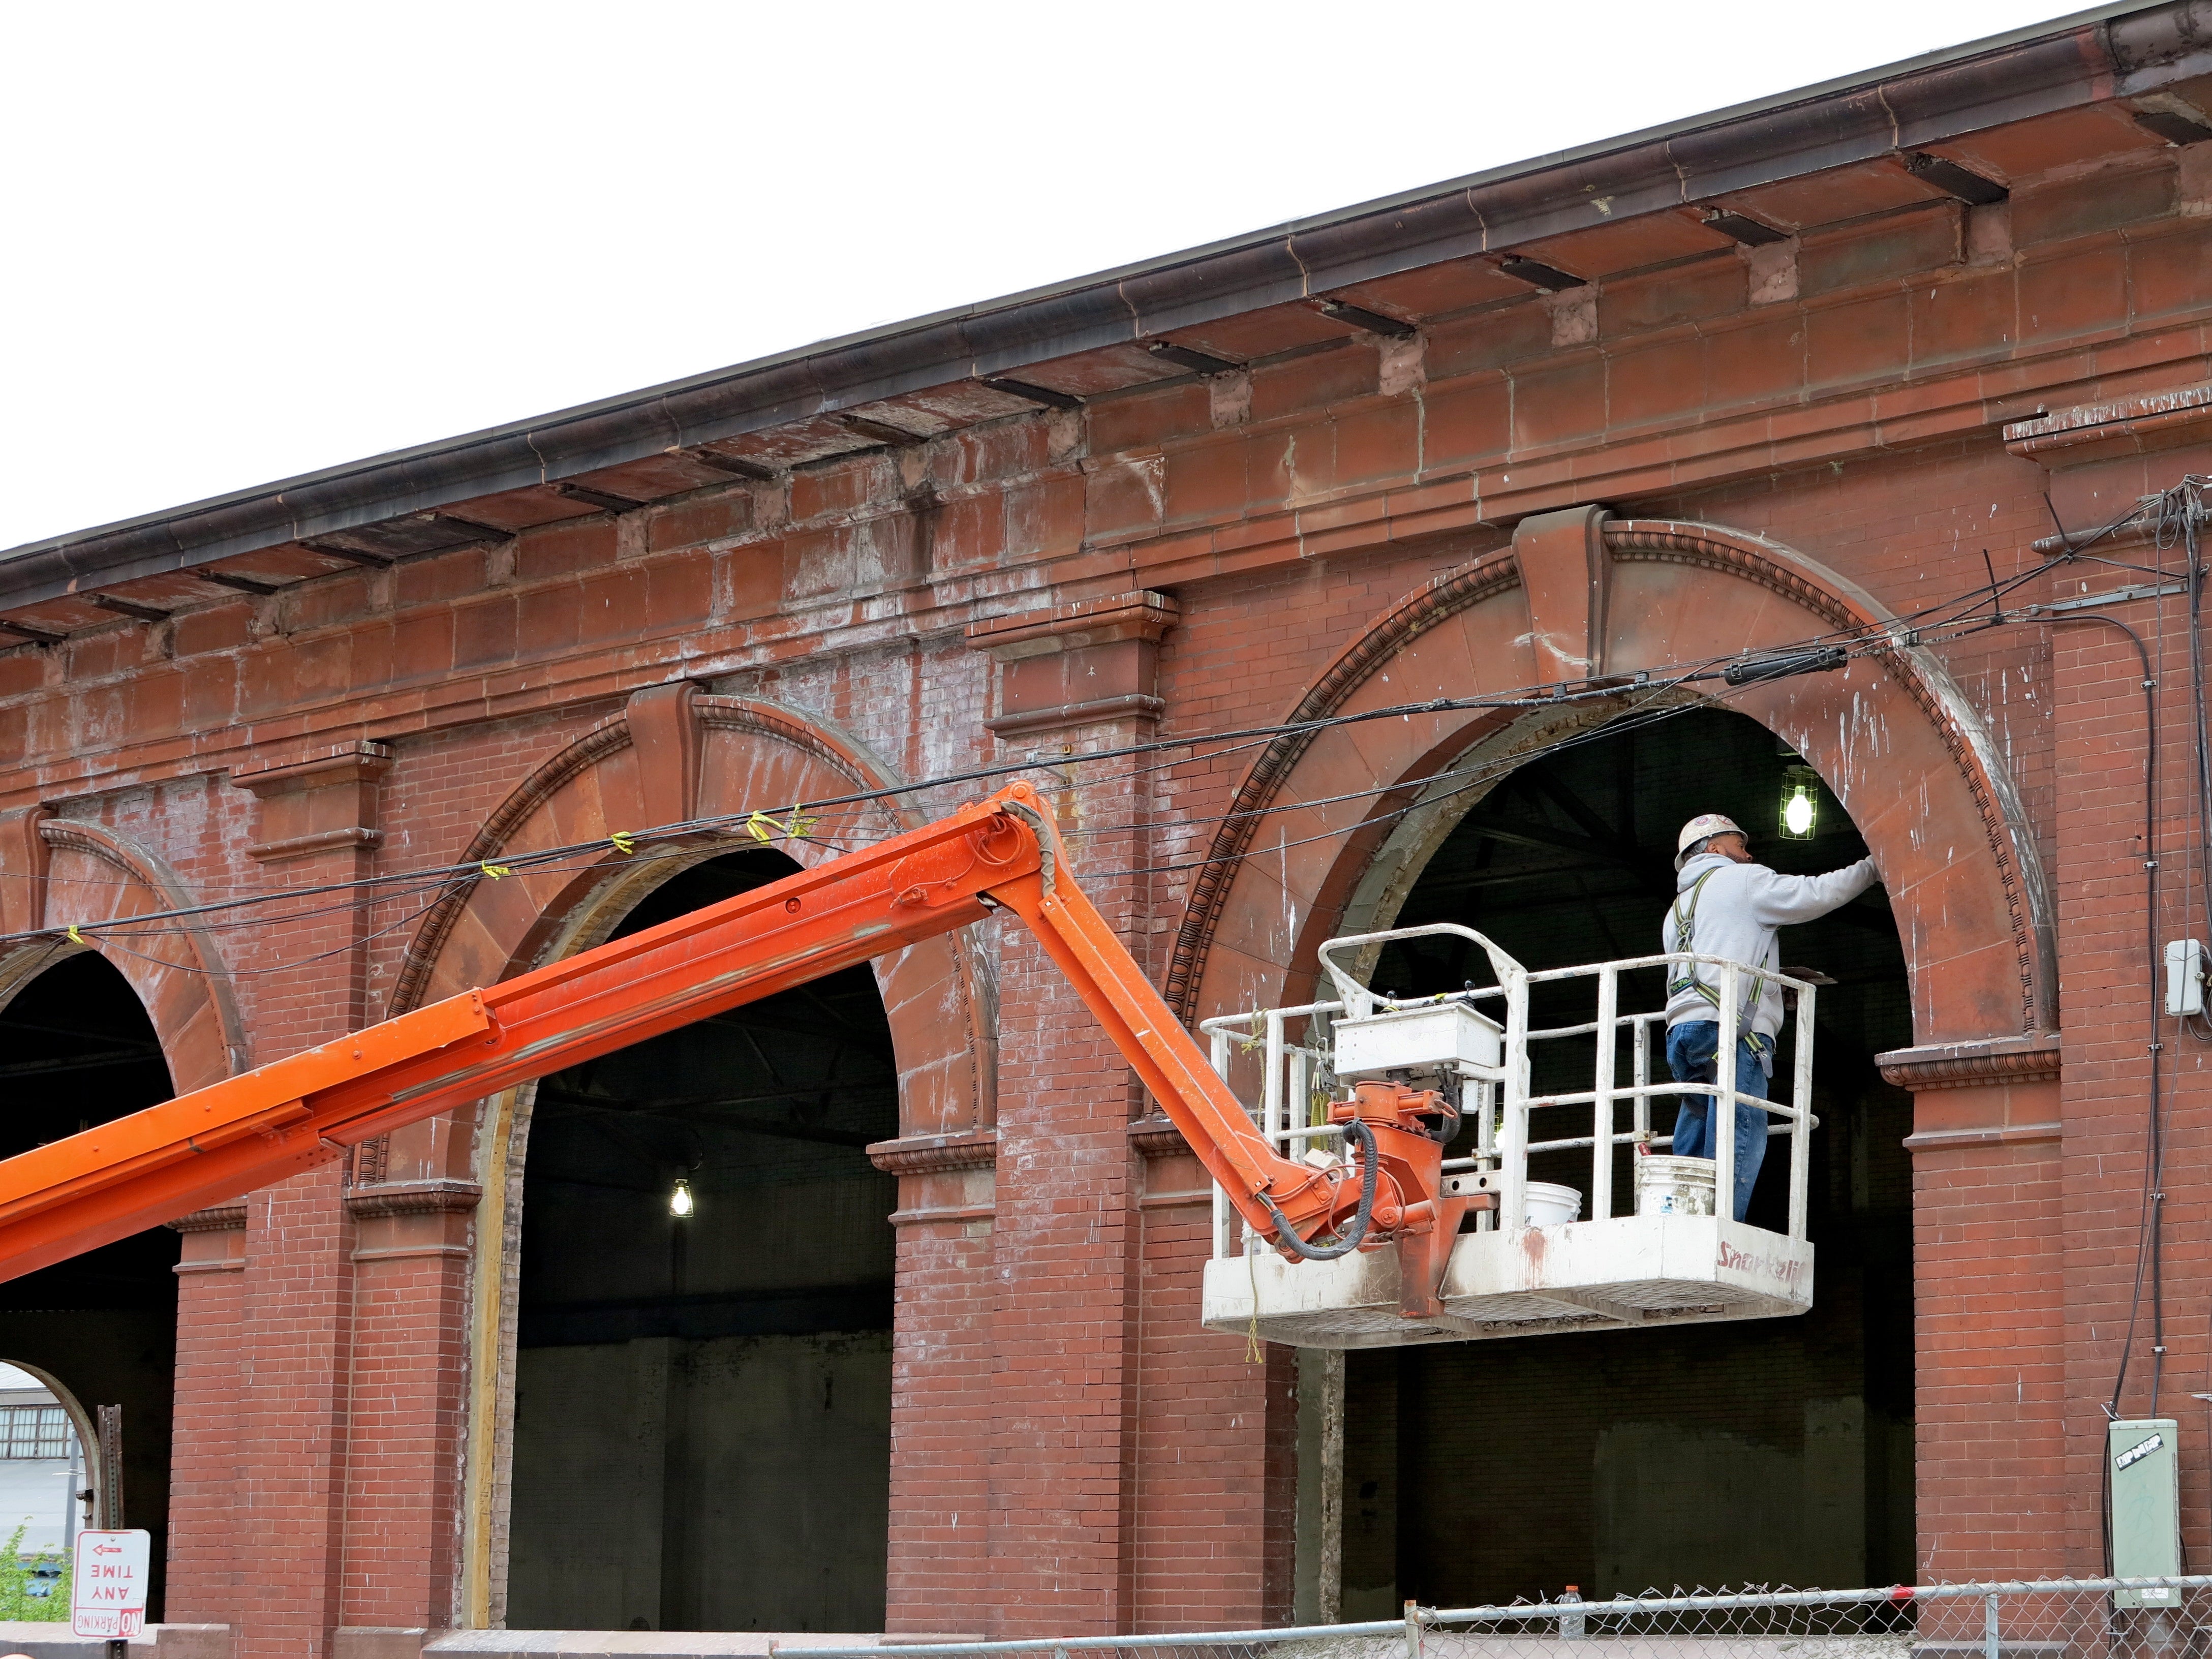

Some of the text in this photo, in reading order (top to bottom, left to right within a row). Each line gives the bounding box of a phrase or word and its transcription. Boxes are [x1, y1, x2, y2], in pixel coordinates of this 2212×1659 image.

[91, 1564, 133, 1578] TIME
[91, 1586, 130, 1600] ANY
[78, 1611, 142, 1633] NO PARKING
